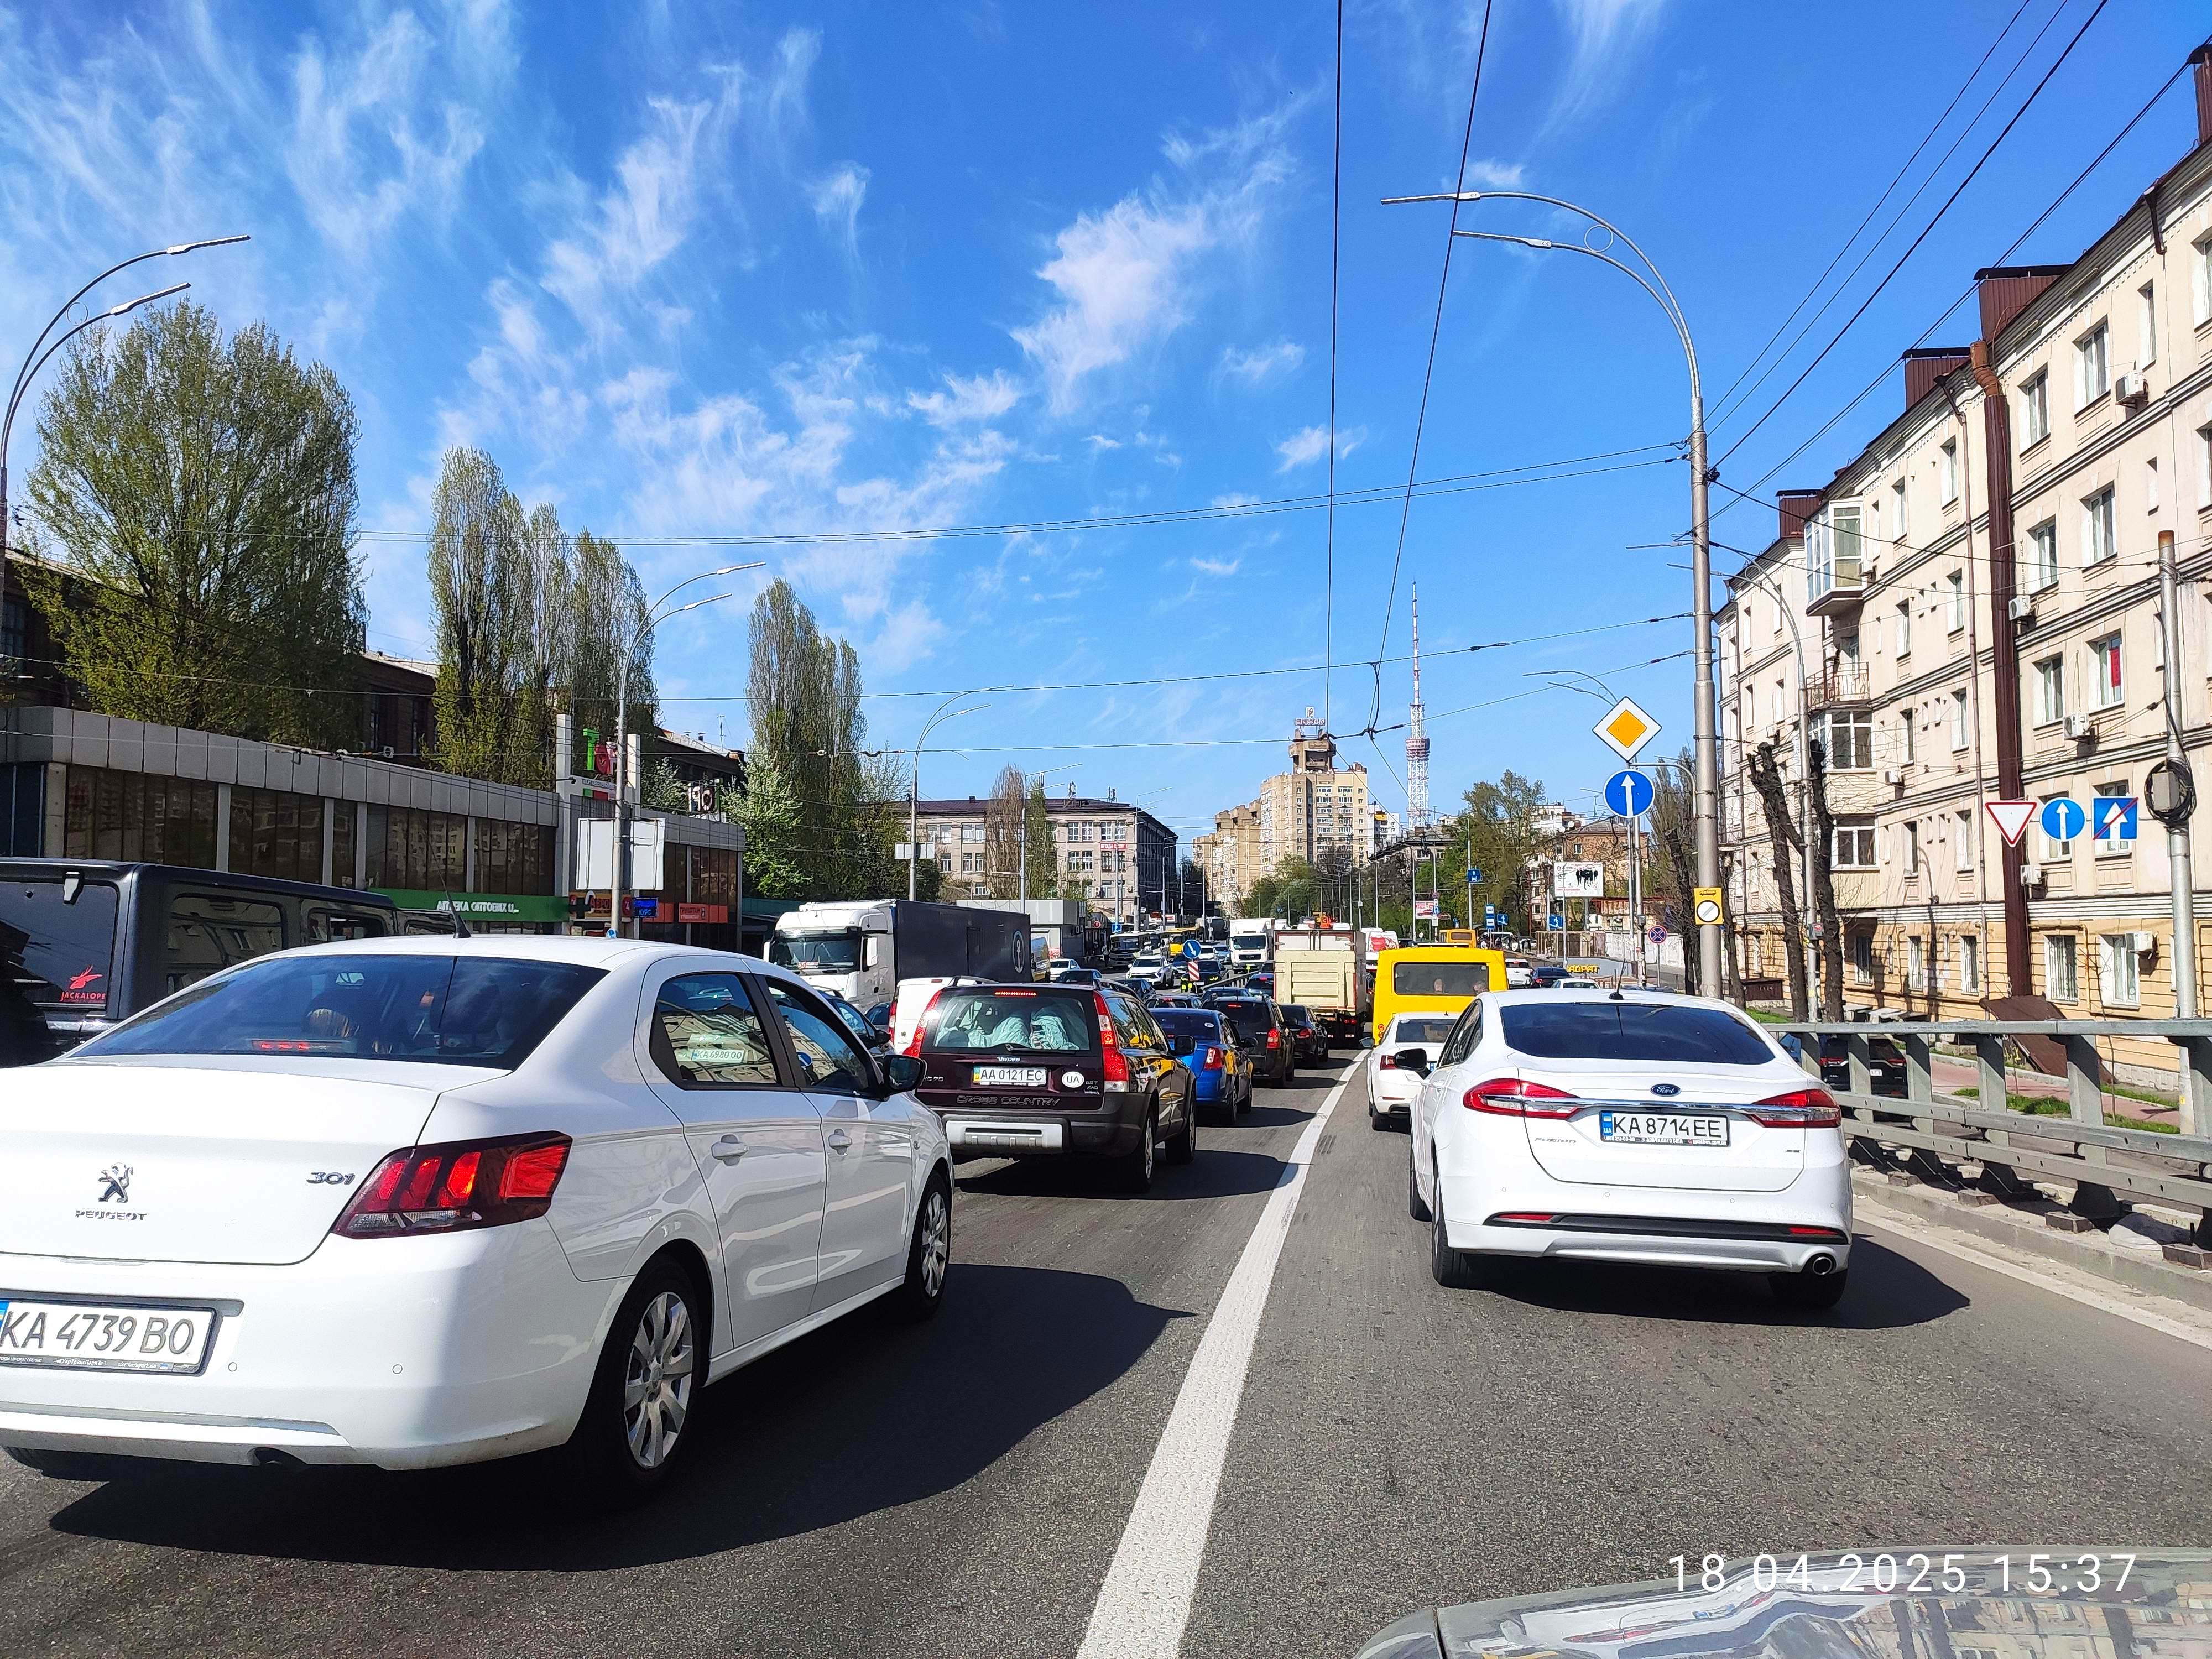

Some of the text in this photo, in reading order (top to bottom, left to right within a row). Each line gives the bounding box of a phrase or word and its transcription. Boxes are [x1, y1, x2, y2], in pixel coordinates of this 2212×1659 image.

[591, 898, 612, 909] АВРО
[59, 992, 106, 1001] JACKALOPE
[981, 1069, 995, 1080] AA
[999, 1070, 1023, 1080] 0121
[1026, 1070, 1042, 1081] EC
[1067, 1075, 1080, 1084] UA
[1656, 1086, 1674, 1094] Ford
[957, 1095, 1060, 1106] CROSS COUNTRY
[1613, 1117, 1641, 1134] KA
[1646, 1118, 1689, 1136] 8714
[1693, 1119, 1721, 1138] EE
[306, 1172, 355, 1185] 301
[75, 1209, 147, 1221] PEUGEOT
[0, 1311, 194, 1355] KA 4739 BO
